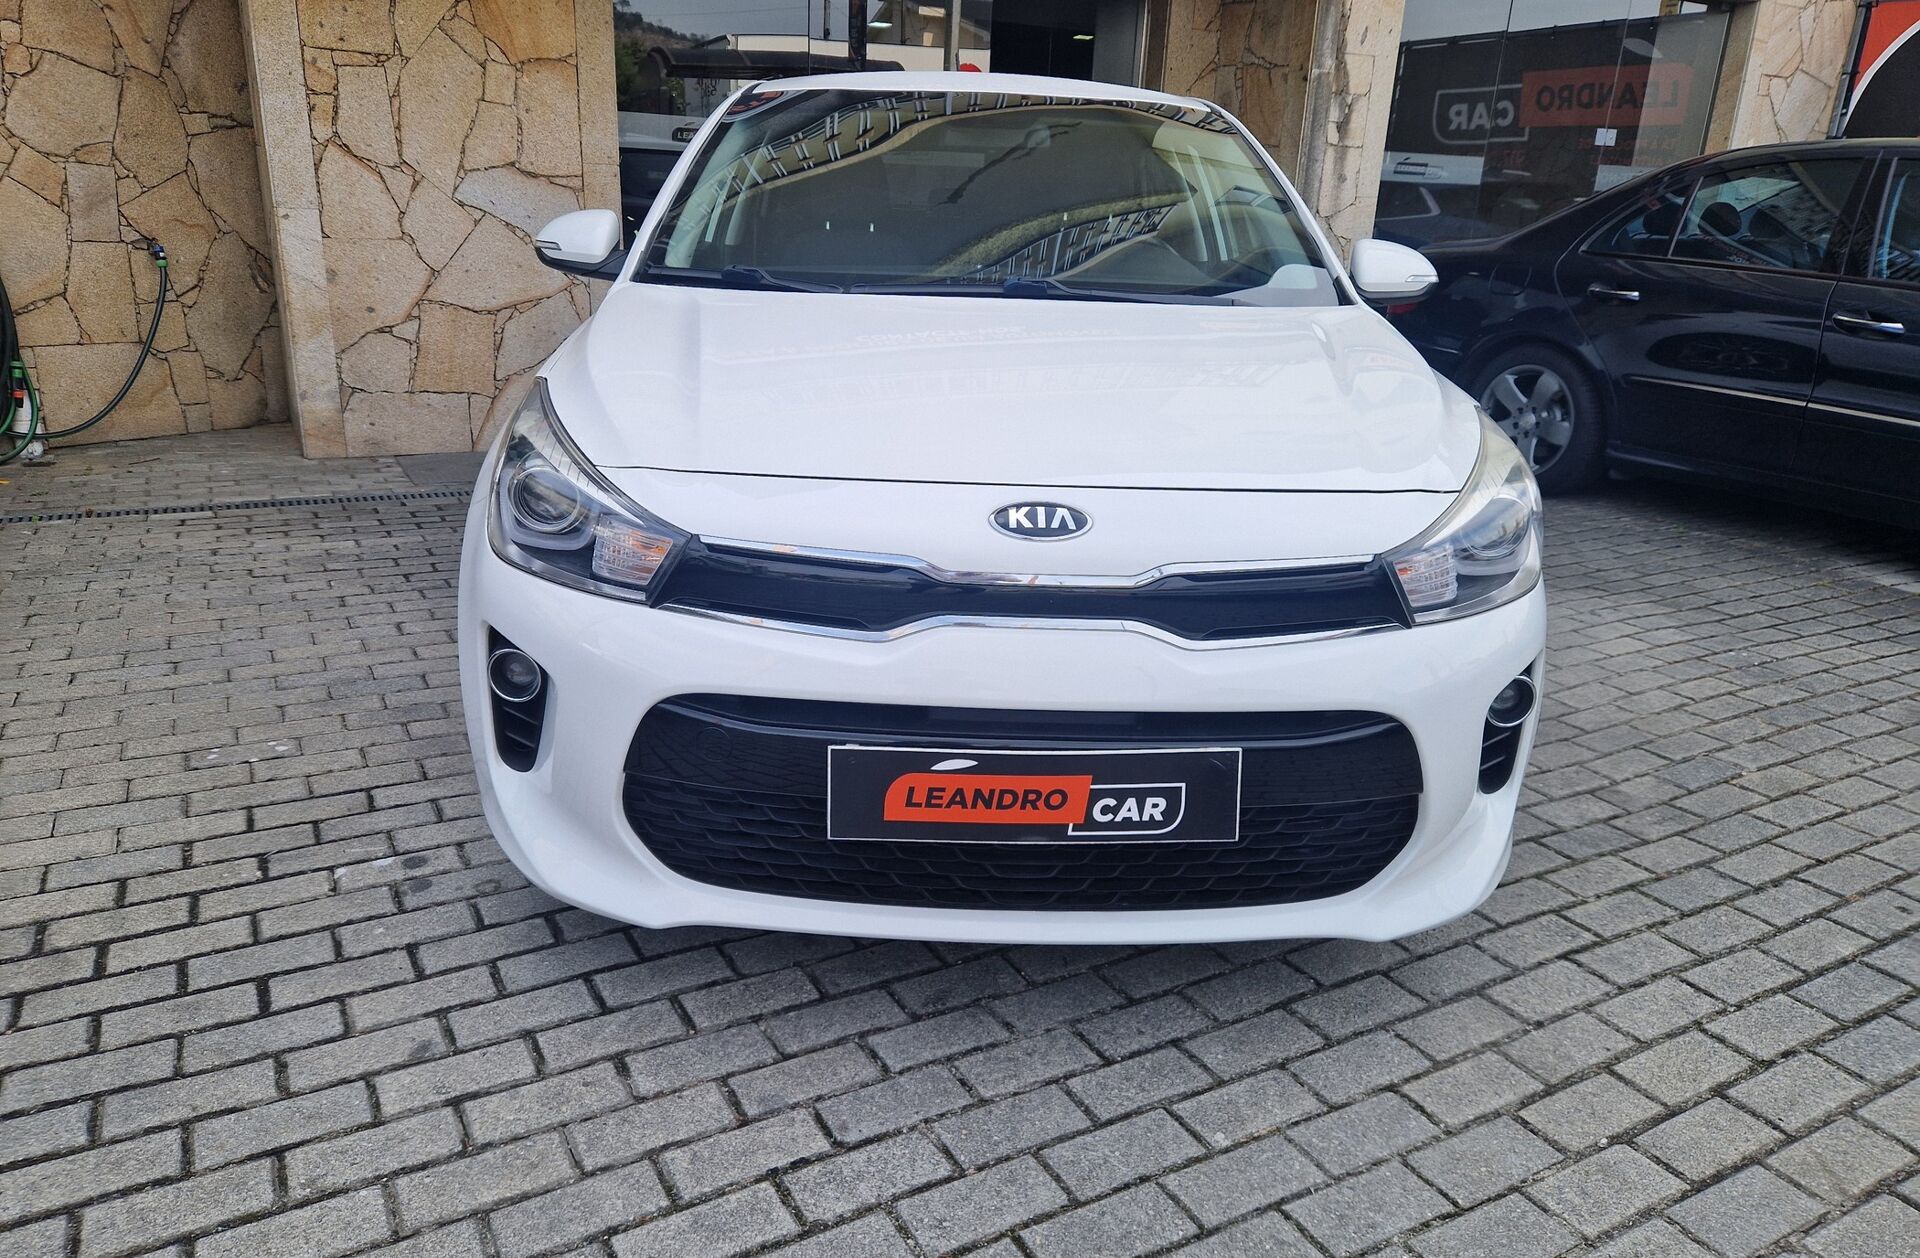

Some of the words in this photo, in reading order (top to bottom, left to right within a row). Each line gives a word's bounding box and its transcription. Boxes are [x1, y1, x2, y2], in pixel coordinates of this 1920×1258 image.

[1007, 506, 1077, 530] KIA
[904, 785, 1069, 811] LEANDRO
[1092, 797, 1167, 823] CAR
